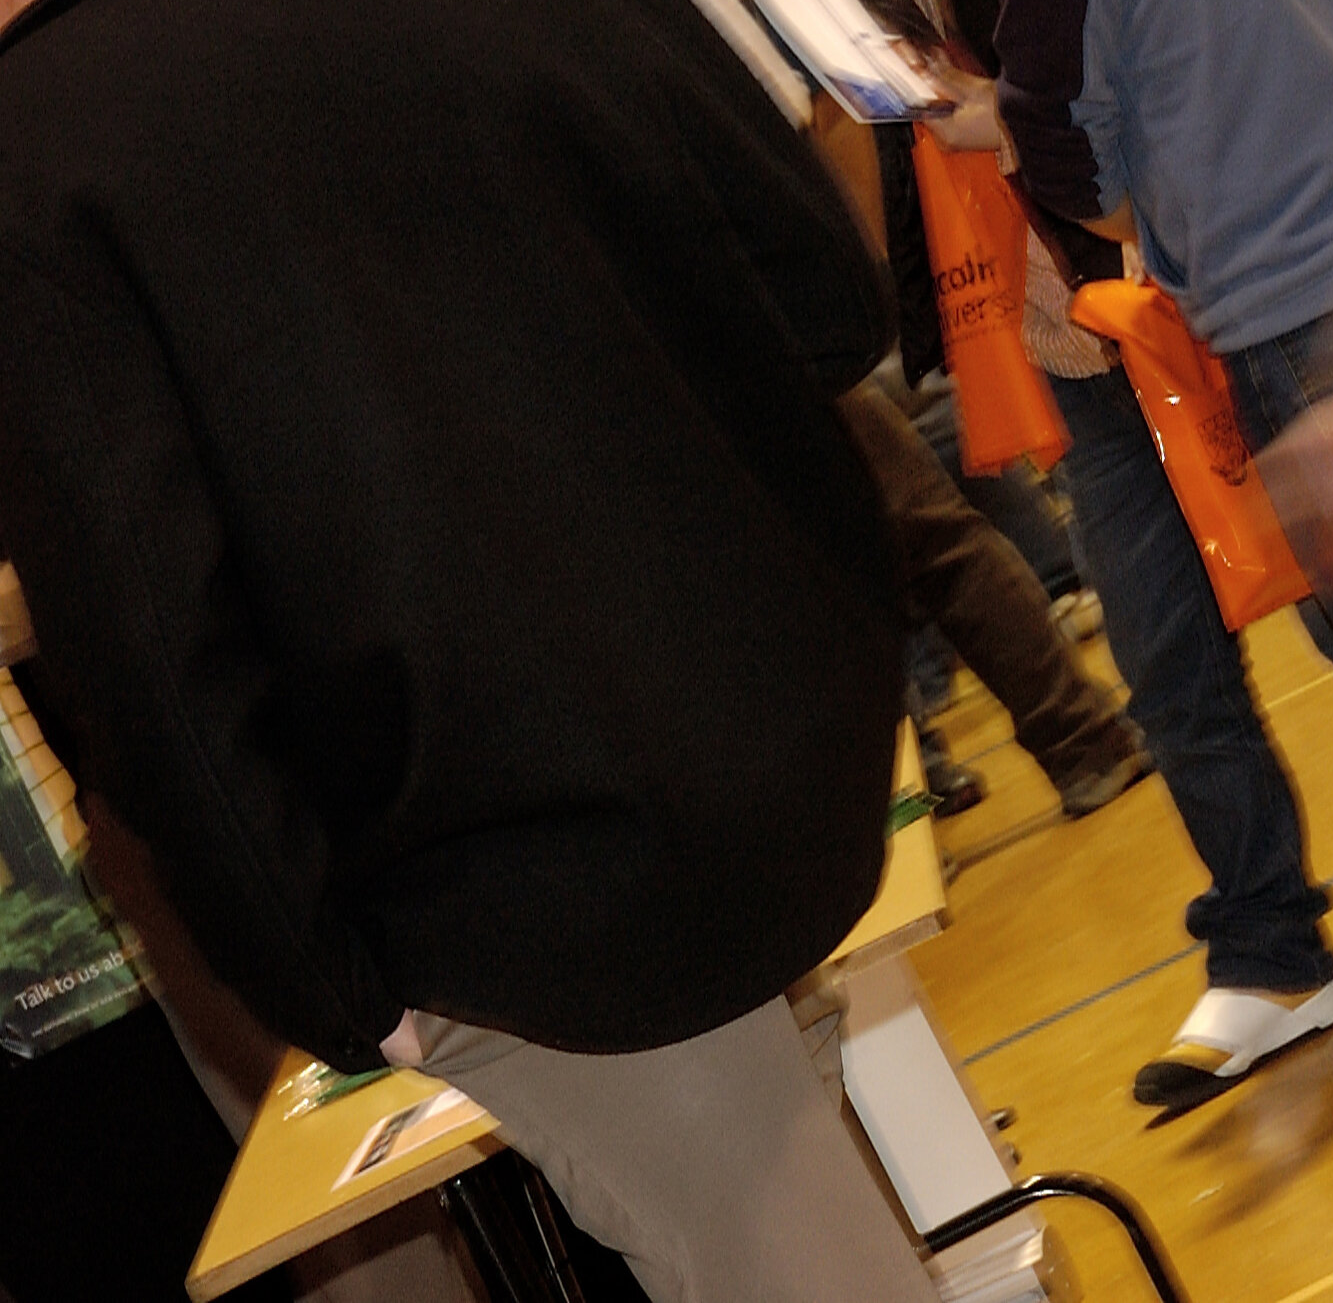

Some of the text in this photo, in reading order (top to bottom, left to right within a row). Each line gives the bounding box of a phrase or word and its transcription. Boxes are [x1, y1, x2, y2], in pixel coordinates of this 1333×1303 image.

[14, 982, 54, 1011] Talk
[54, 976, 75, 995] to
[77, 963, 100, 984] us
